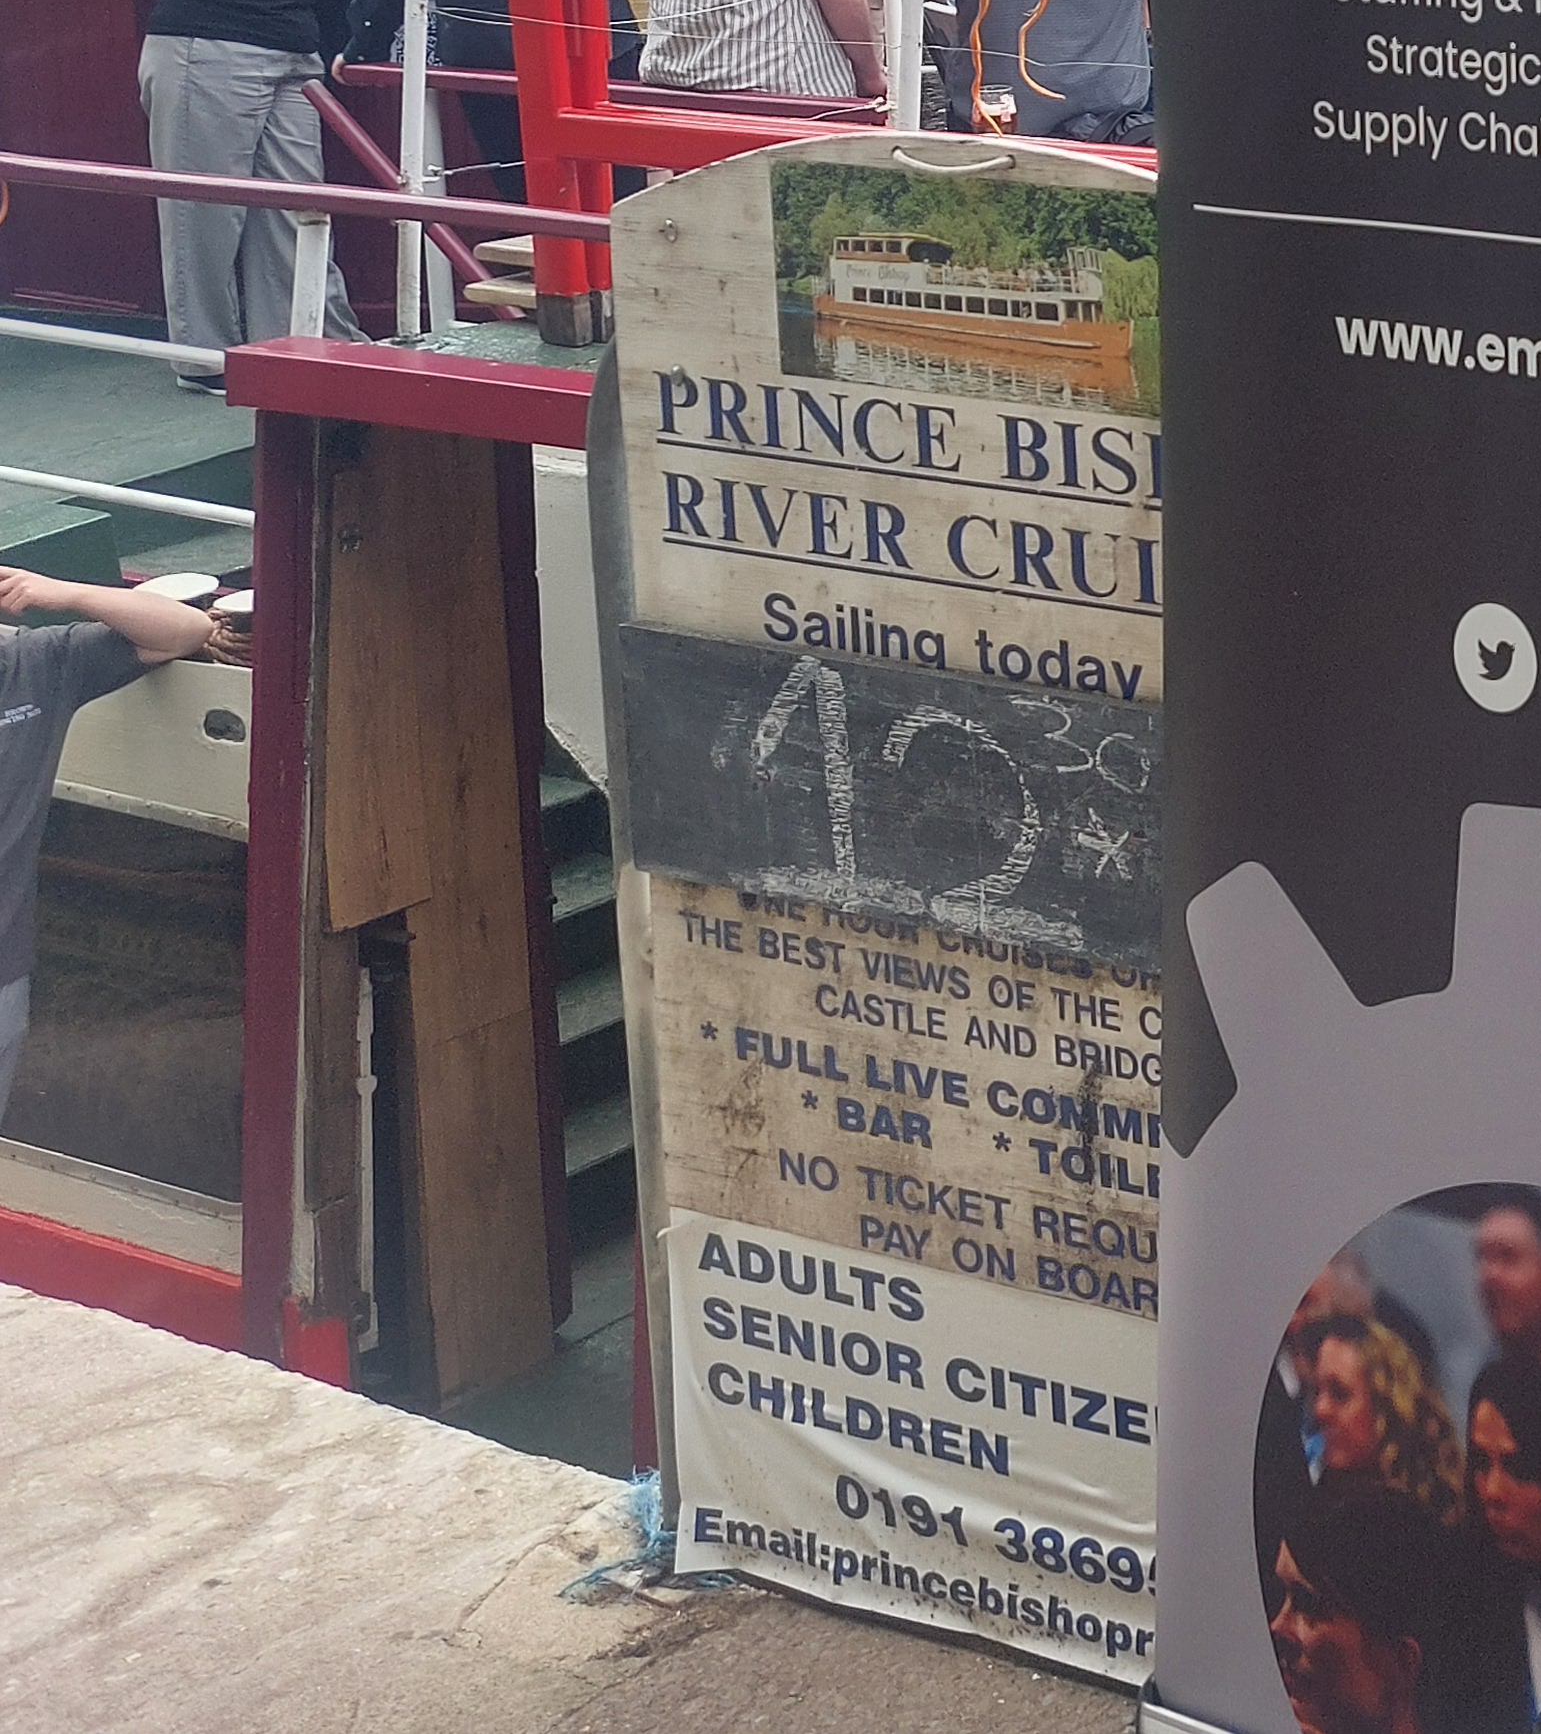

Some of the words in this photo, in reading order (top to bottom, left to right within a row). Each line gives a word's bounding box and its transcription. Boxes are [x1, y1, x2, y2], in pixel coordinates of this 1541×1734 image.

[1366, 34, 1541, 96] Strategic
[1313, 100, 1449, 161] Supply
[652, 370, 962, 473] PRINCE
[662, 471, 914, 570] RIVER
[947, 515, 1162, 605] CRUI
[763, 592, 946, 670] Sailing
[976, 629, 1143, 701] today
[679, 909, 744, 954] THE
[758, 926, 847, 974] BEST
[856, 946, 971, 1000] VIEWS
[988, 974, 1037, 1011] OF
[1050, 986, 1122, 1033] THE
[816, 983, 948, 1041] CASTLE
[964, 1015, 1038, 1059] AND
[735, 1026, 849, 1083] FULL
[866, 1054, 970, 1108] LIVE
[837, 1096, 933, 1150] BAR
[778, 1147, 840, 1193] NO
[857, 1165, 1012, 1231] TICKET
[1033, 1204, 1158, 1264] REQU
[697, 1232, 926, 1322] ADULTS
[860, 1213, 930, 1261] PAY
[953, 1238, 1016, 1282] ON
[1036, 1255, 1158, 1311] BOAR
[702, 1296, 926, 1391] SENIOR
[944, 1357, 1158, 1446] CITIZE
[707, 1362, 1011, 1477] CHILDREN
[834, 1474, 968, 1547] 0191
[993, 1517, 1157, 1597] 3869
